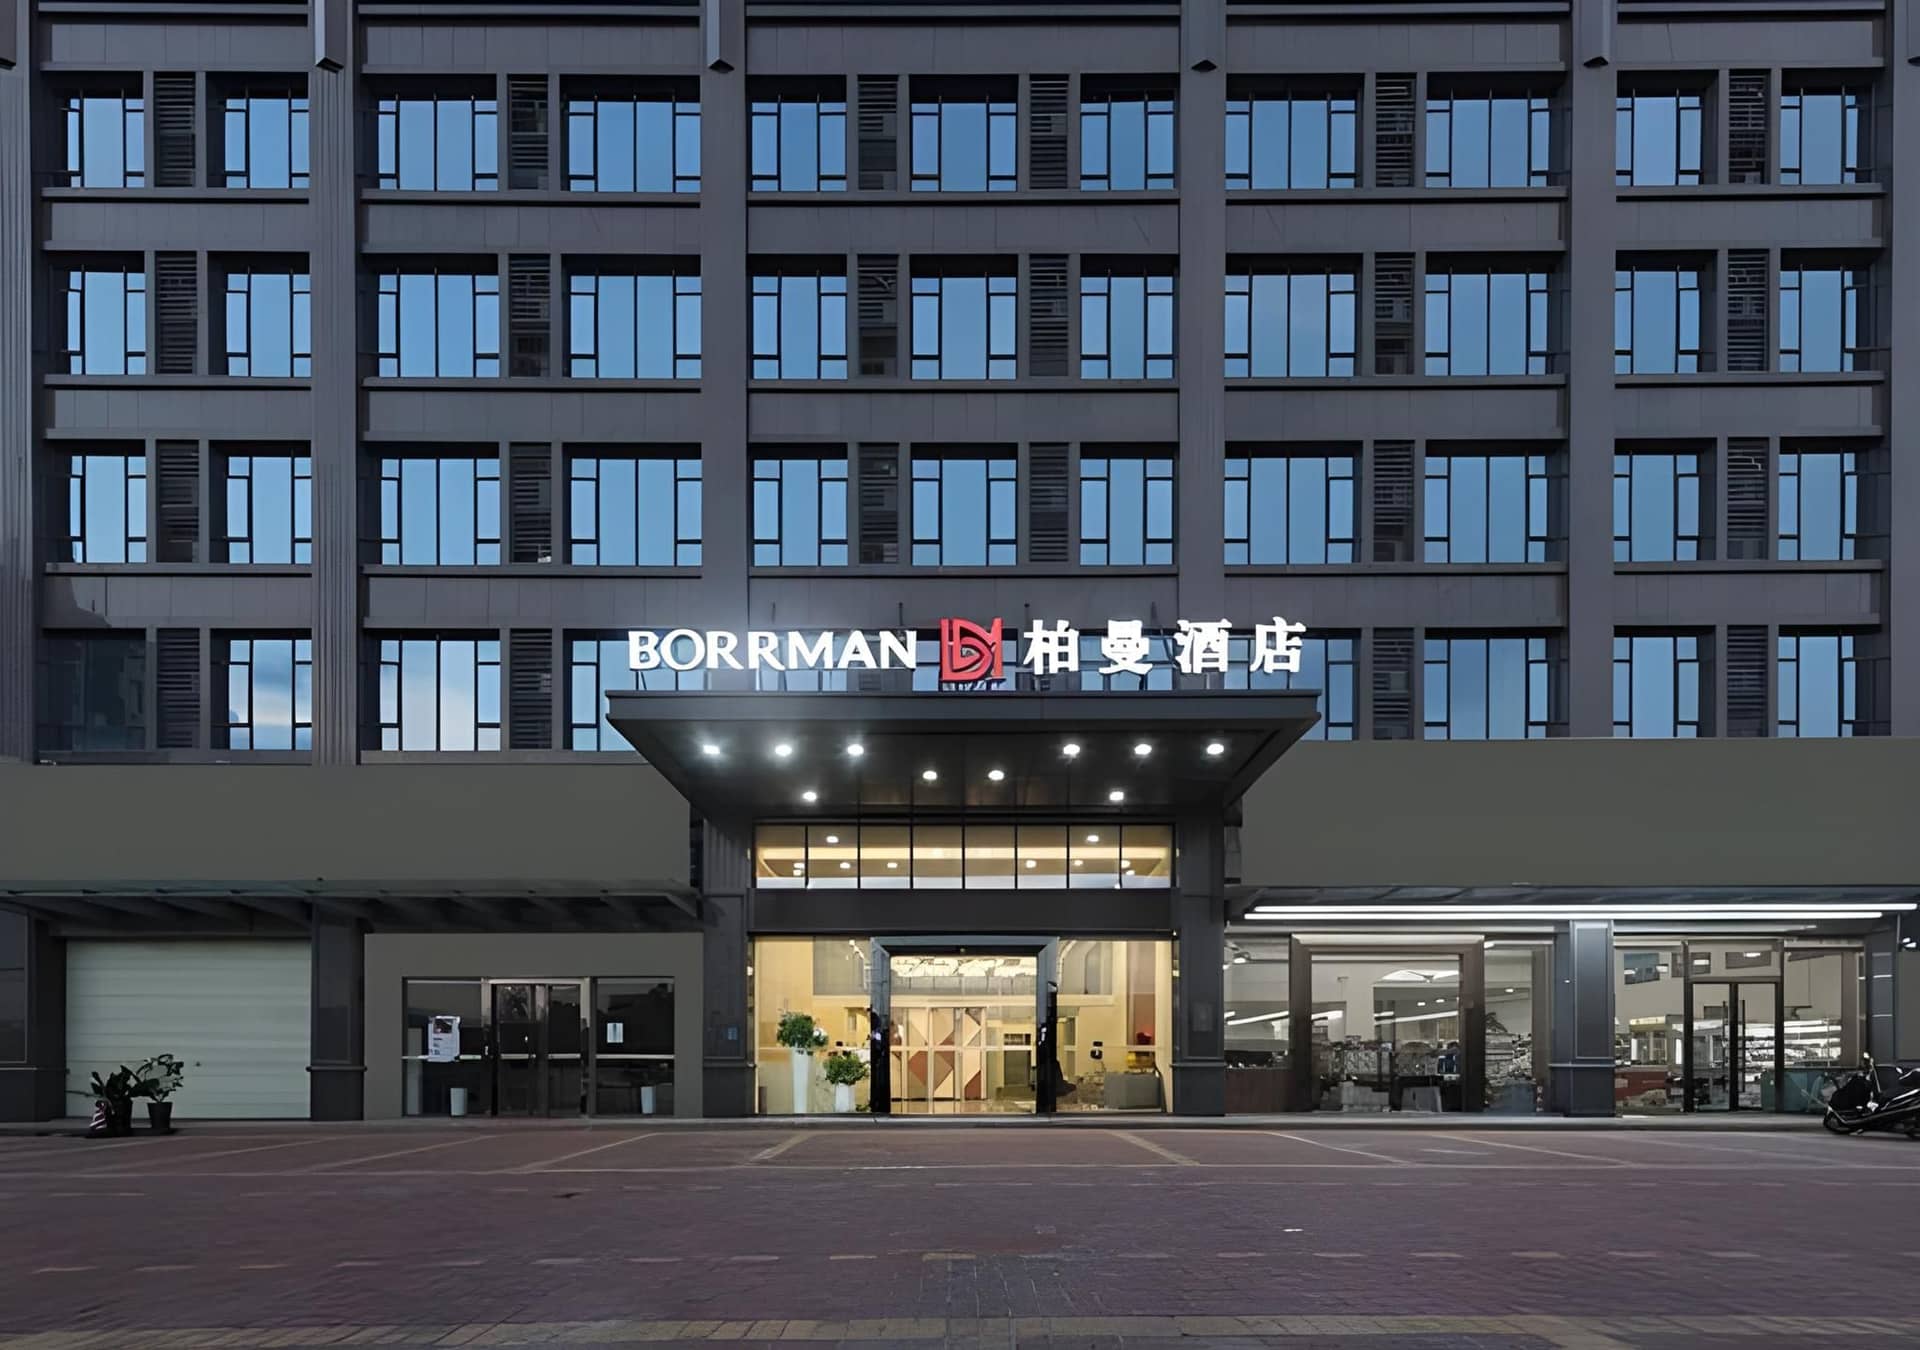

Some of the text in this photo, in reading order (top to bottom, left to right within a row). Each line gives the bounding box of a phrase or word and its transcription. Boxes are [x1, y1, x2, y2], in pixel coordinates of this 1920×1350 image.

[628, 628, 917, 671] BORRMAN
[1023, 616, 1307, 676] 柏曼酒店
